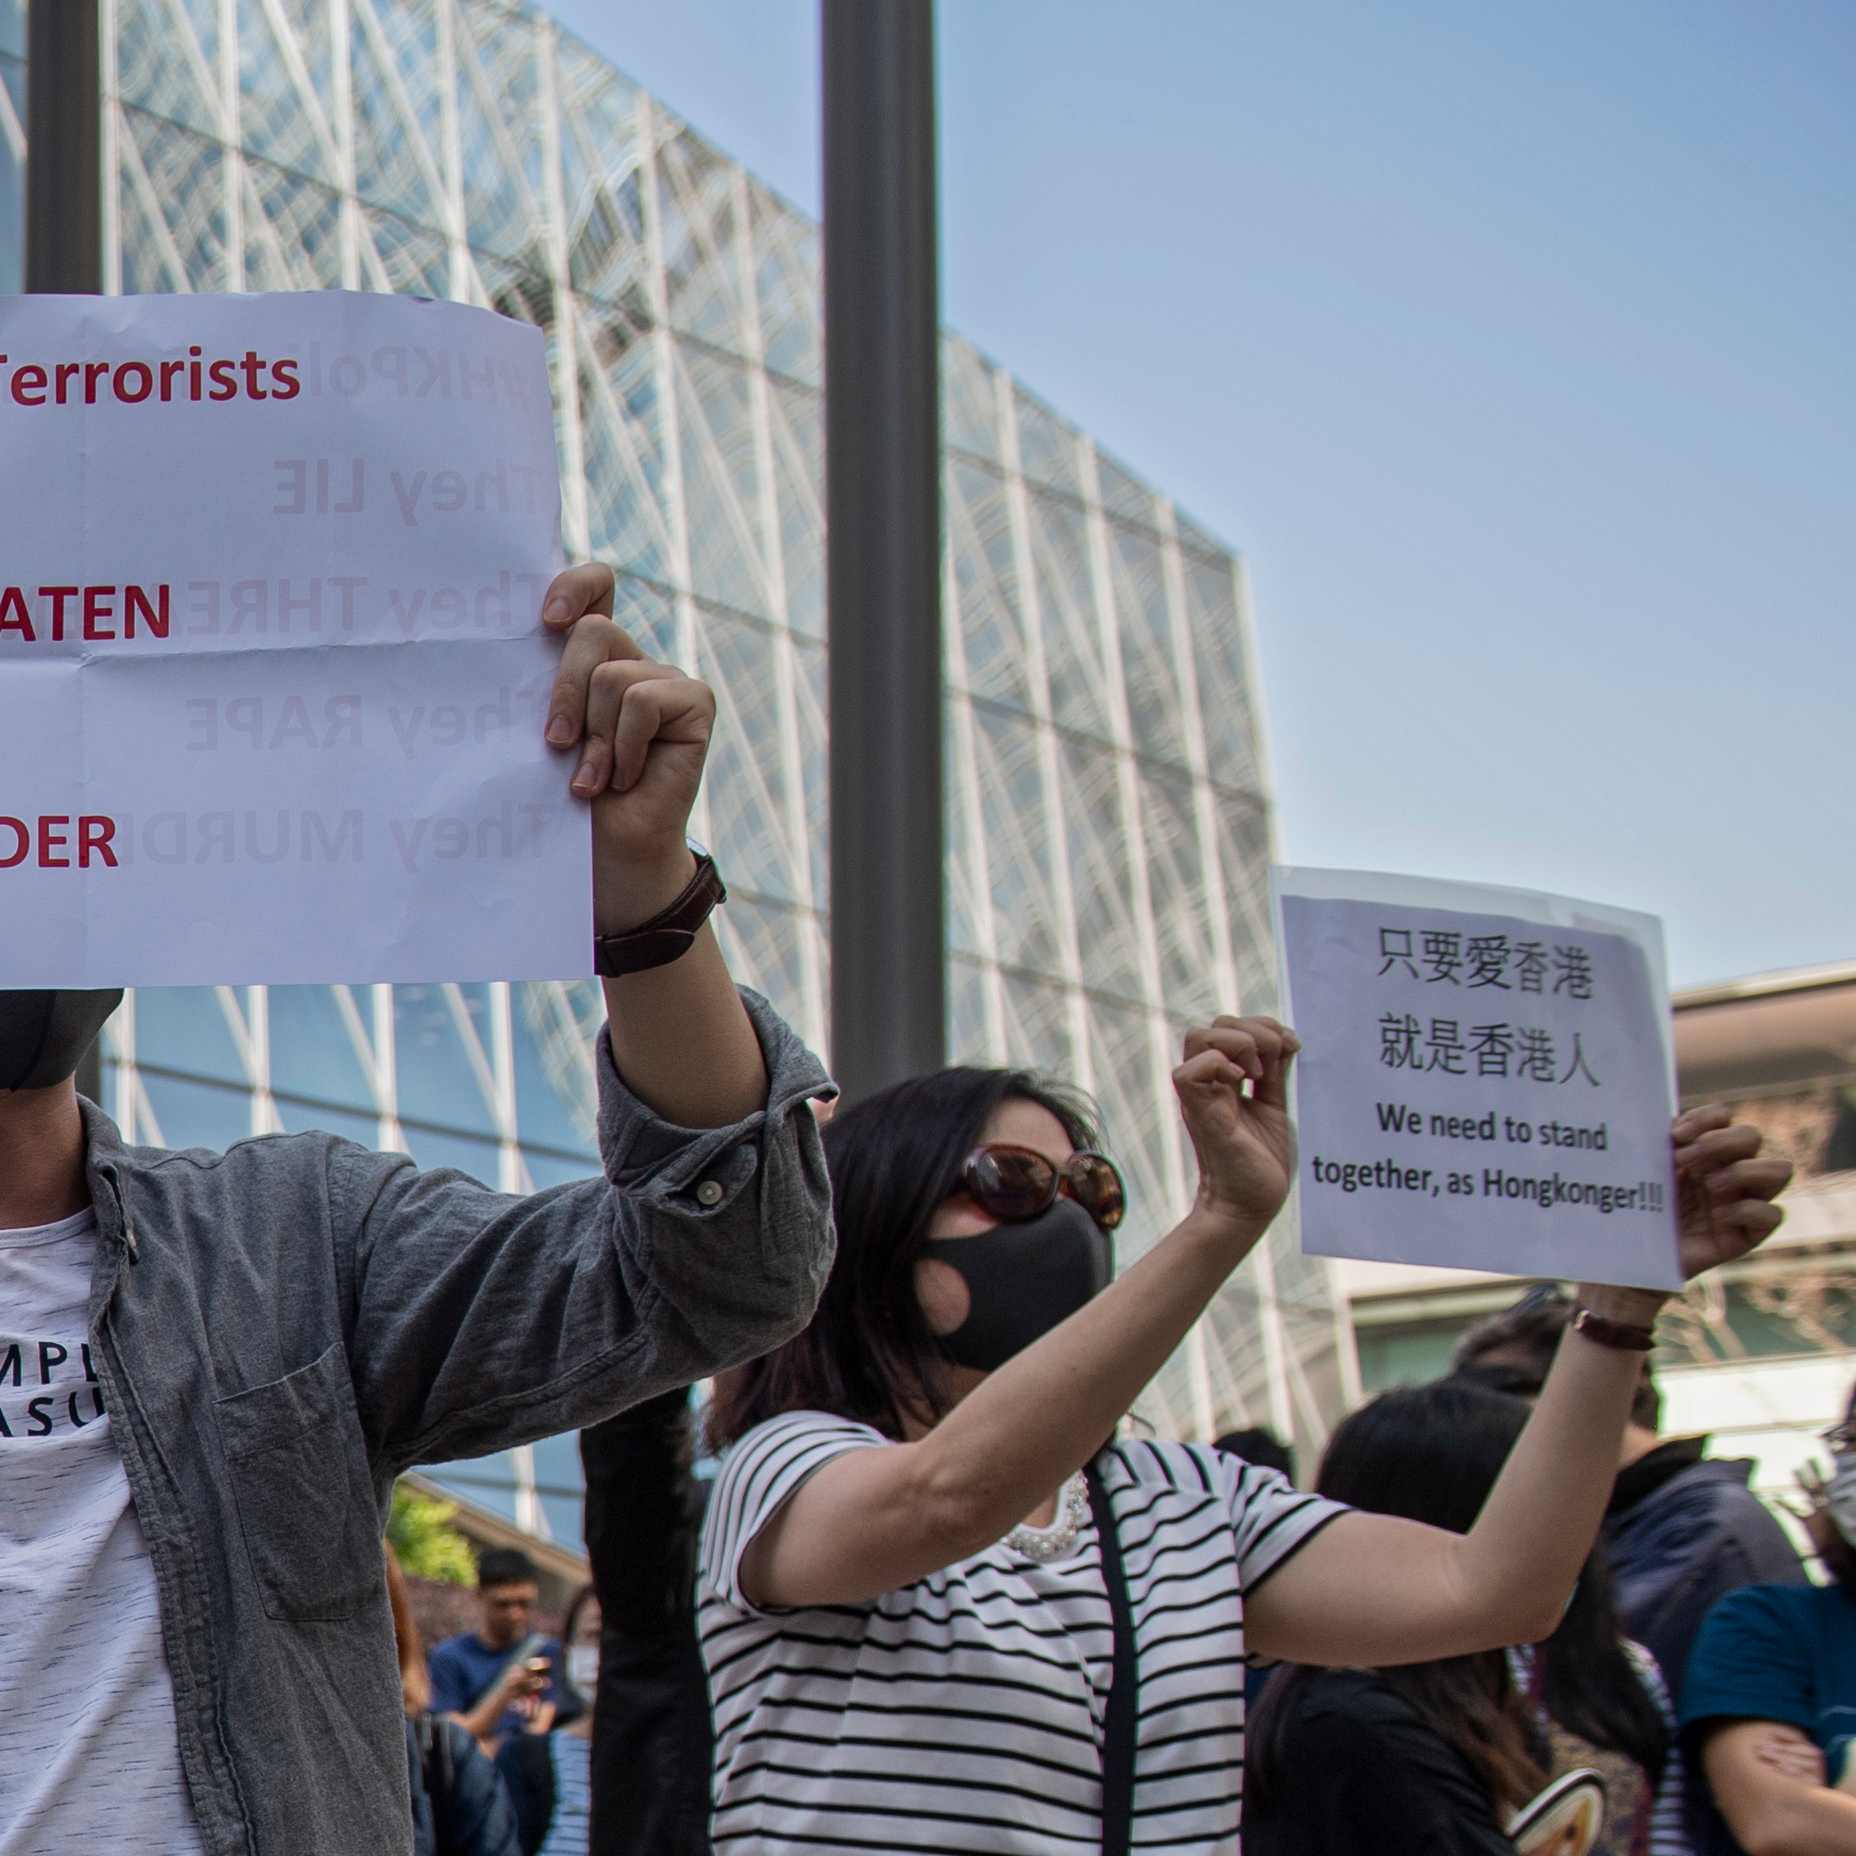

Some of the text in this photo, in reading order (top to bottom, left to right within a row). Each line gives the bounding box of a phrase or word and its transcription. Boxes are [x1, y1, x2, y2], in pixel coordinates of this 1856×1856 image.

[1378, 926, 1594, 1000] 只要愛香港
[1378, 1011, 1601, 1087] 就是香港人
[1376, 1101, 1608, 1151] We need to stand
[1313, 1156, 1664, 1214] together, as Hongkonger!!!
